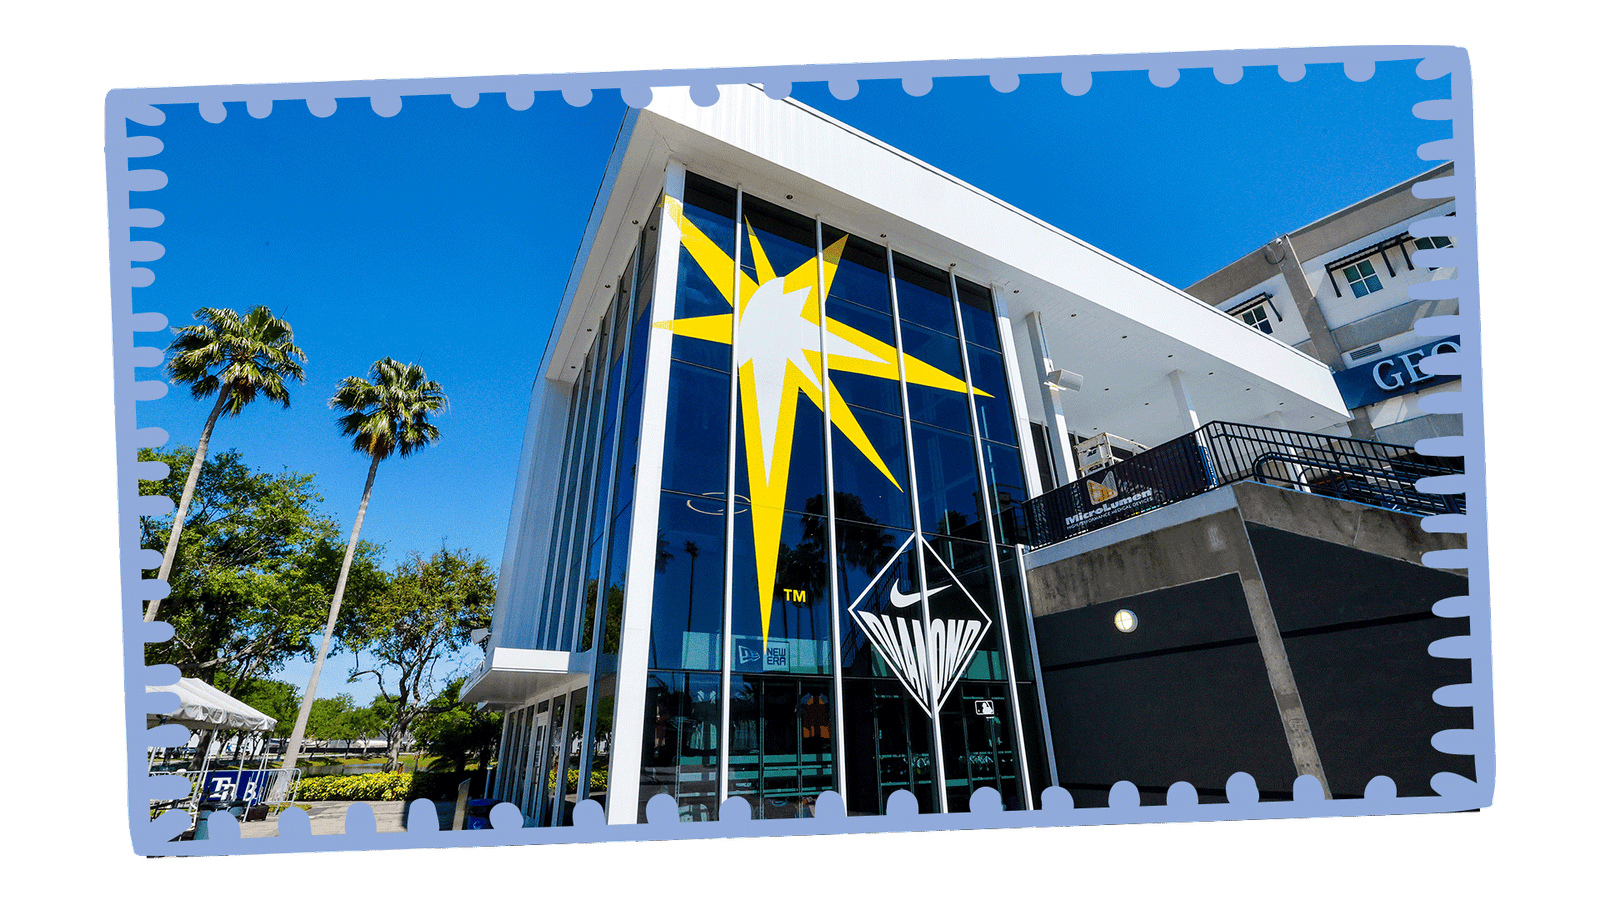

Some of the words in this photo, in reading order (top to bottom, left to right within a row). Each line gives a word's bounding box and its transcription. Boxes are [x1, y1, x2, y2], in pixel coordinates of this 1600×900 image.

[1065, 488, 1152, 525] MicroLumen
[1111, 504, 1131, 514] MEDICAL
[1131, 496, 1153, 507] DEVICES
[783, 588, 806, 603] TM
[767, 647, 786, 657] NEW
[857, 610, 982, 707] DIAMOND
[767, 657, 786, 666] ERA
